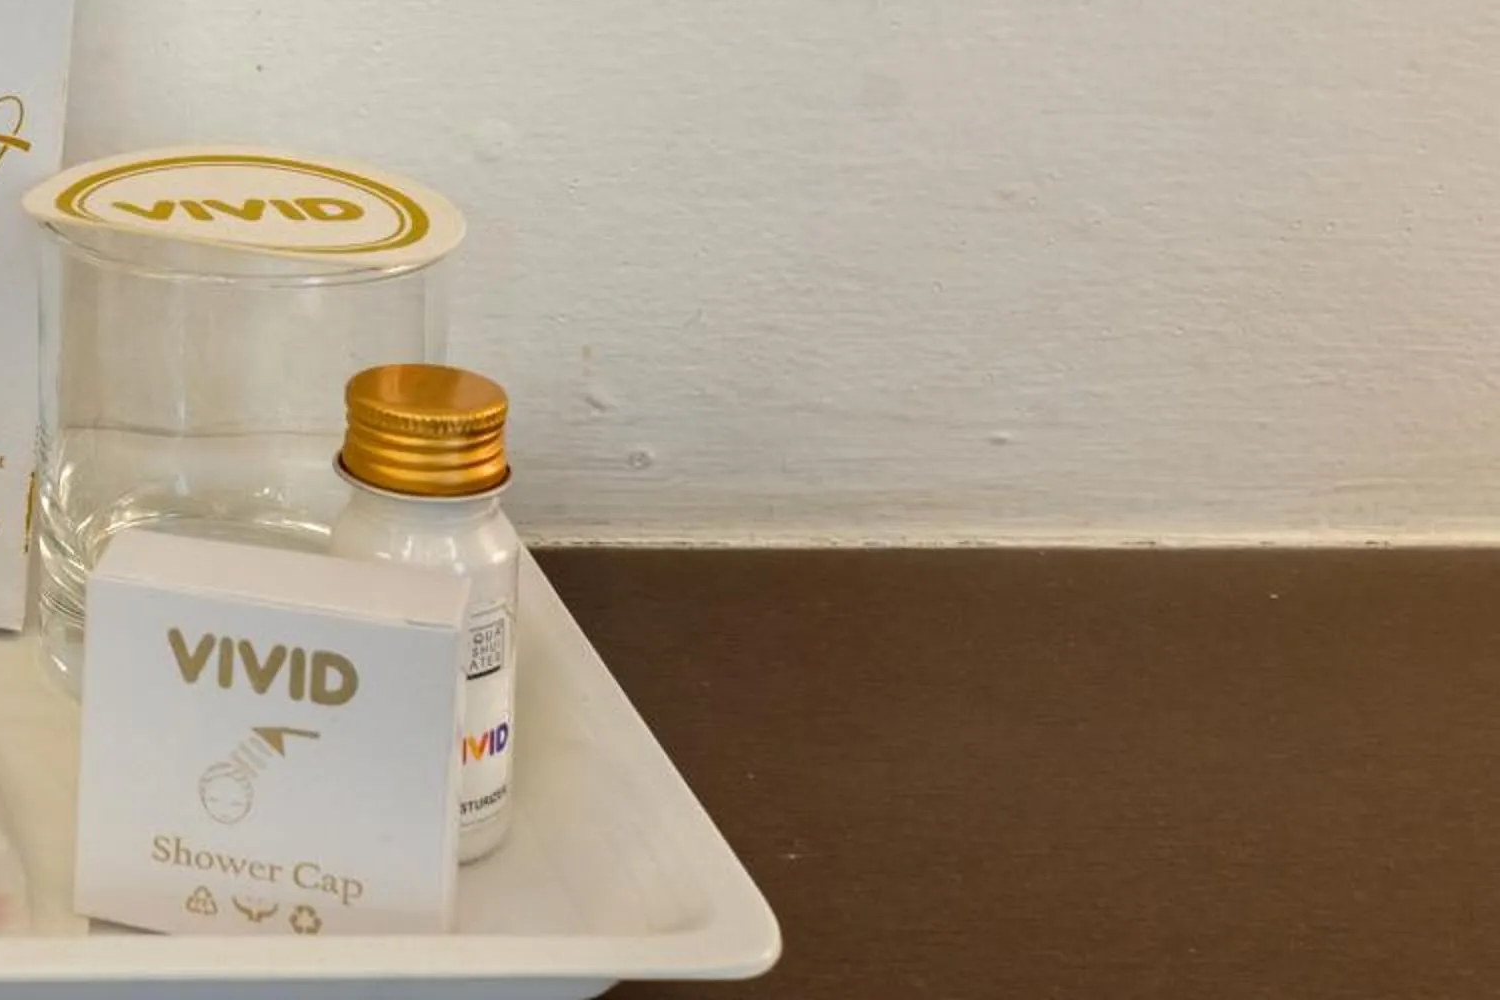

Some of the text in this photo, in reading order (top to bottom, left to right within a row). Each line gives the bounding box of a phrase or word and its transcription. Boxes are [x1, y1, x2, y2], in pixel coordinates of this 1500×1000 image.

[111, 198, 365, 222] VIVID
[167, 627, 359, 706] VIVID
[462, 722, 509, 766] IVID
[152, 834, 364, 905] Shower Cap
